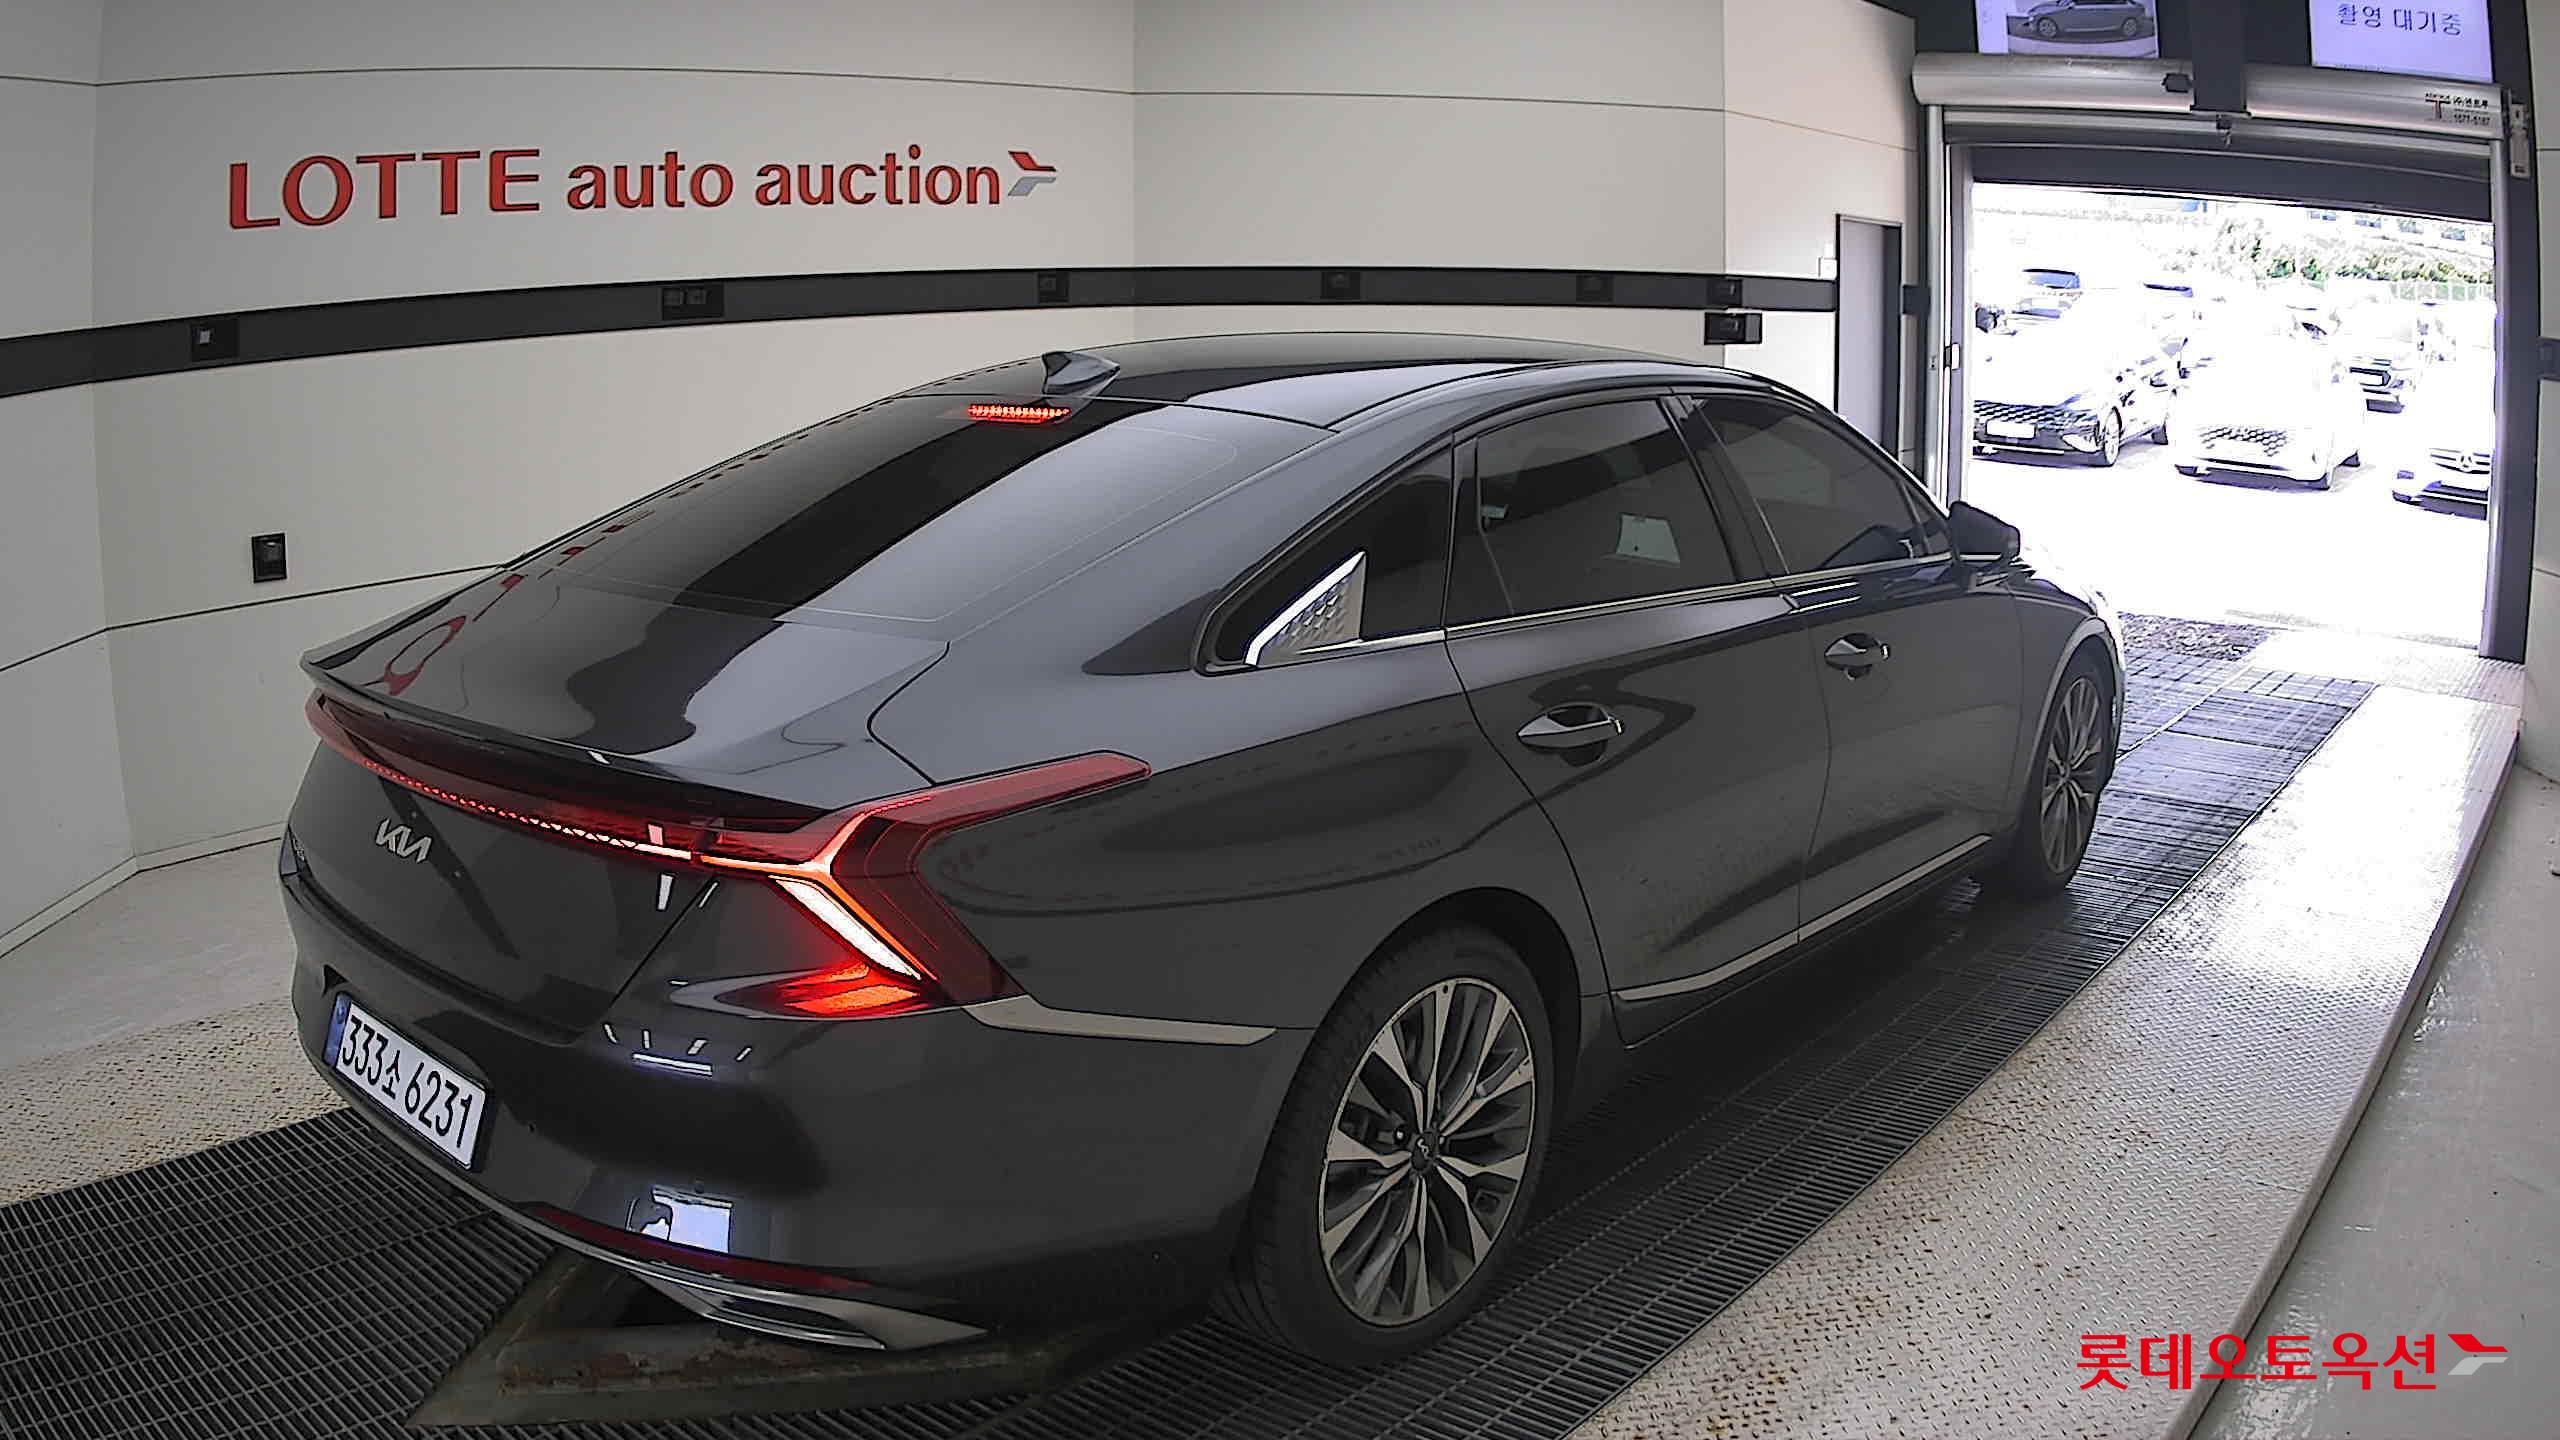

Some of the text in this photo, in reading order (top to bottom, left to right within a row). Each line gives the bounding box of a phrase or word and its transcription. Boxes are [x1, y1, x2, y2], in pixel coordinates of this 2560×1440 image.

[2393, 9, 2461, 36] 대기중
[229, 144, 1001, 230] LOTTE auto auction
[404, 1061, 473, 1149] 6231
